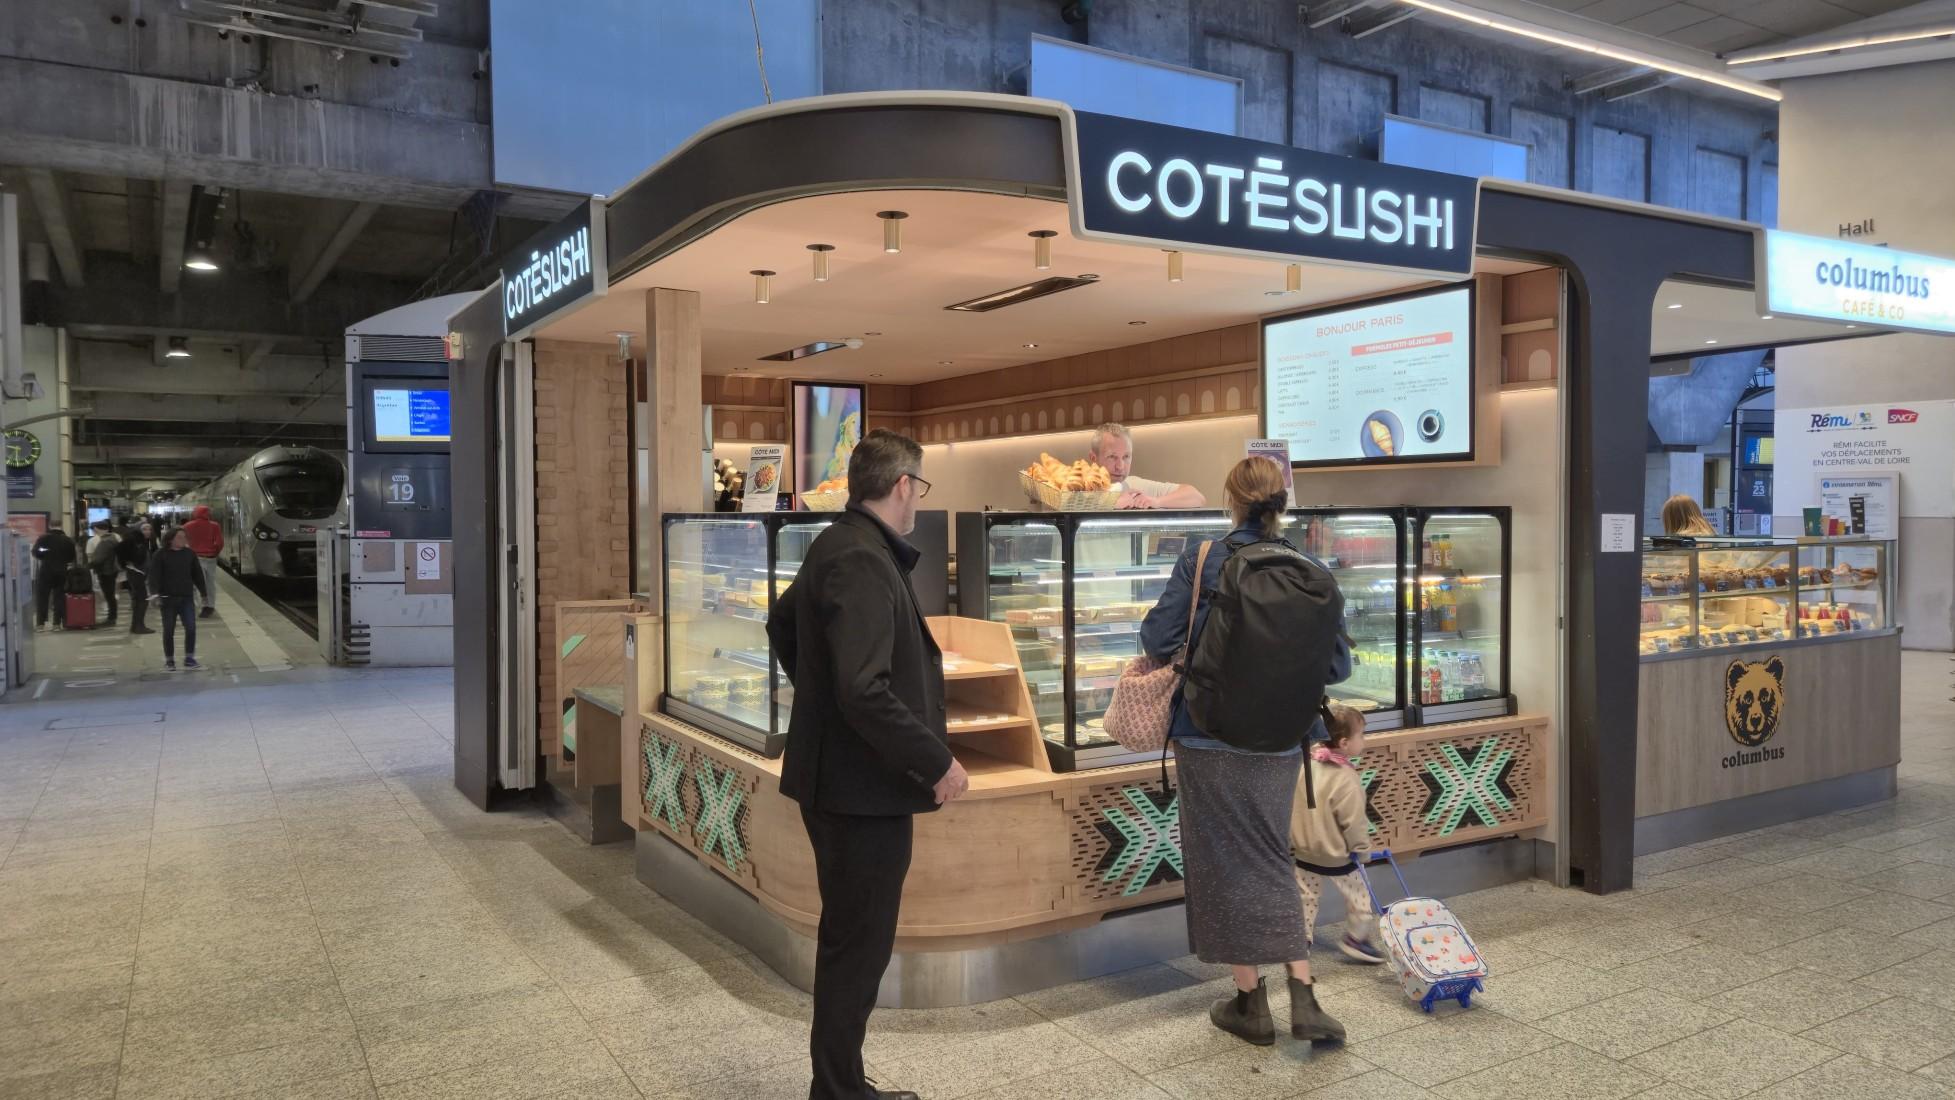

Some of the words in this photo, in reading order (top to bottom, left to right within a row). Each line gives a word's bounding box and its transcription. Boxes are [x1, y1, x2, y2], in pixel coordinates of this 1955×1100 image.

[1838, 218, 1875, 237] Hall
[1816, 257, 1930, 299] columbus
[1888, 306, 1905, 320] CO
[1316, 320, 1367, 337] BONJOUR
[1370, 314, 1404, 328] PARIS
[1811, 412, 1852, 428] Rémi
[1889, 413, 1917, 423] SNCF
[1854, 440, 1887, 448] FACILITE
[1838, 448, 1902, 457] DÉPLACEMENTS
[1813, 459, 1824, 467] EN
[1874, 457, 1885, 465] DE
[389, 483, 414, 501] 19
[1752, 485, 1765, 495] 23
[1721, 745, 1785, 769] columbus
